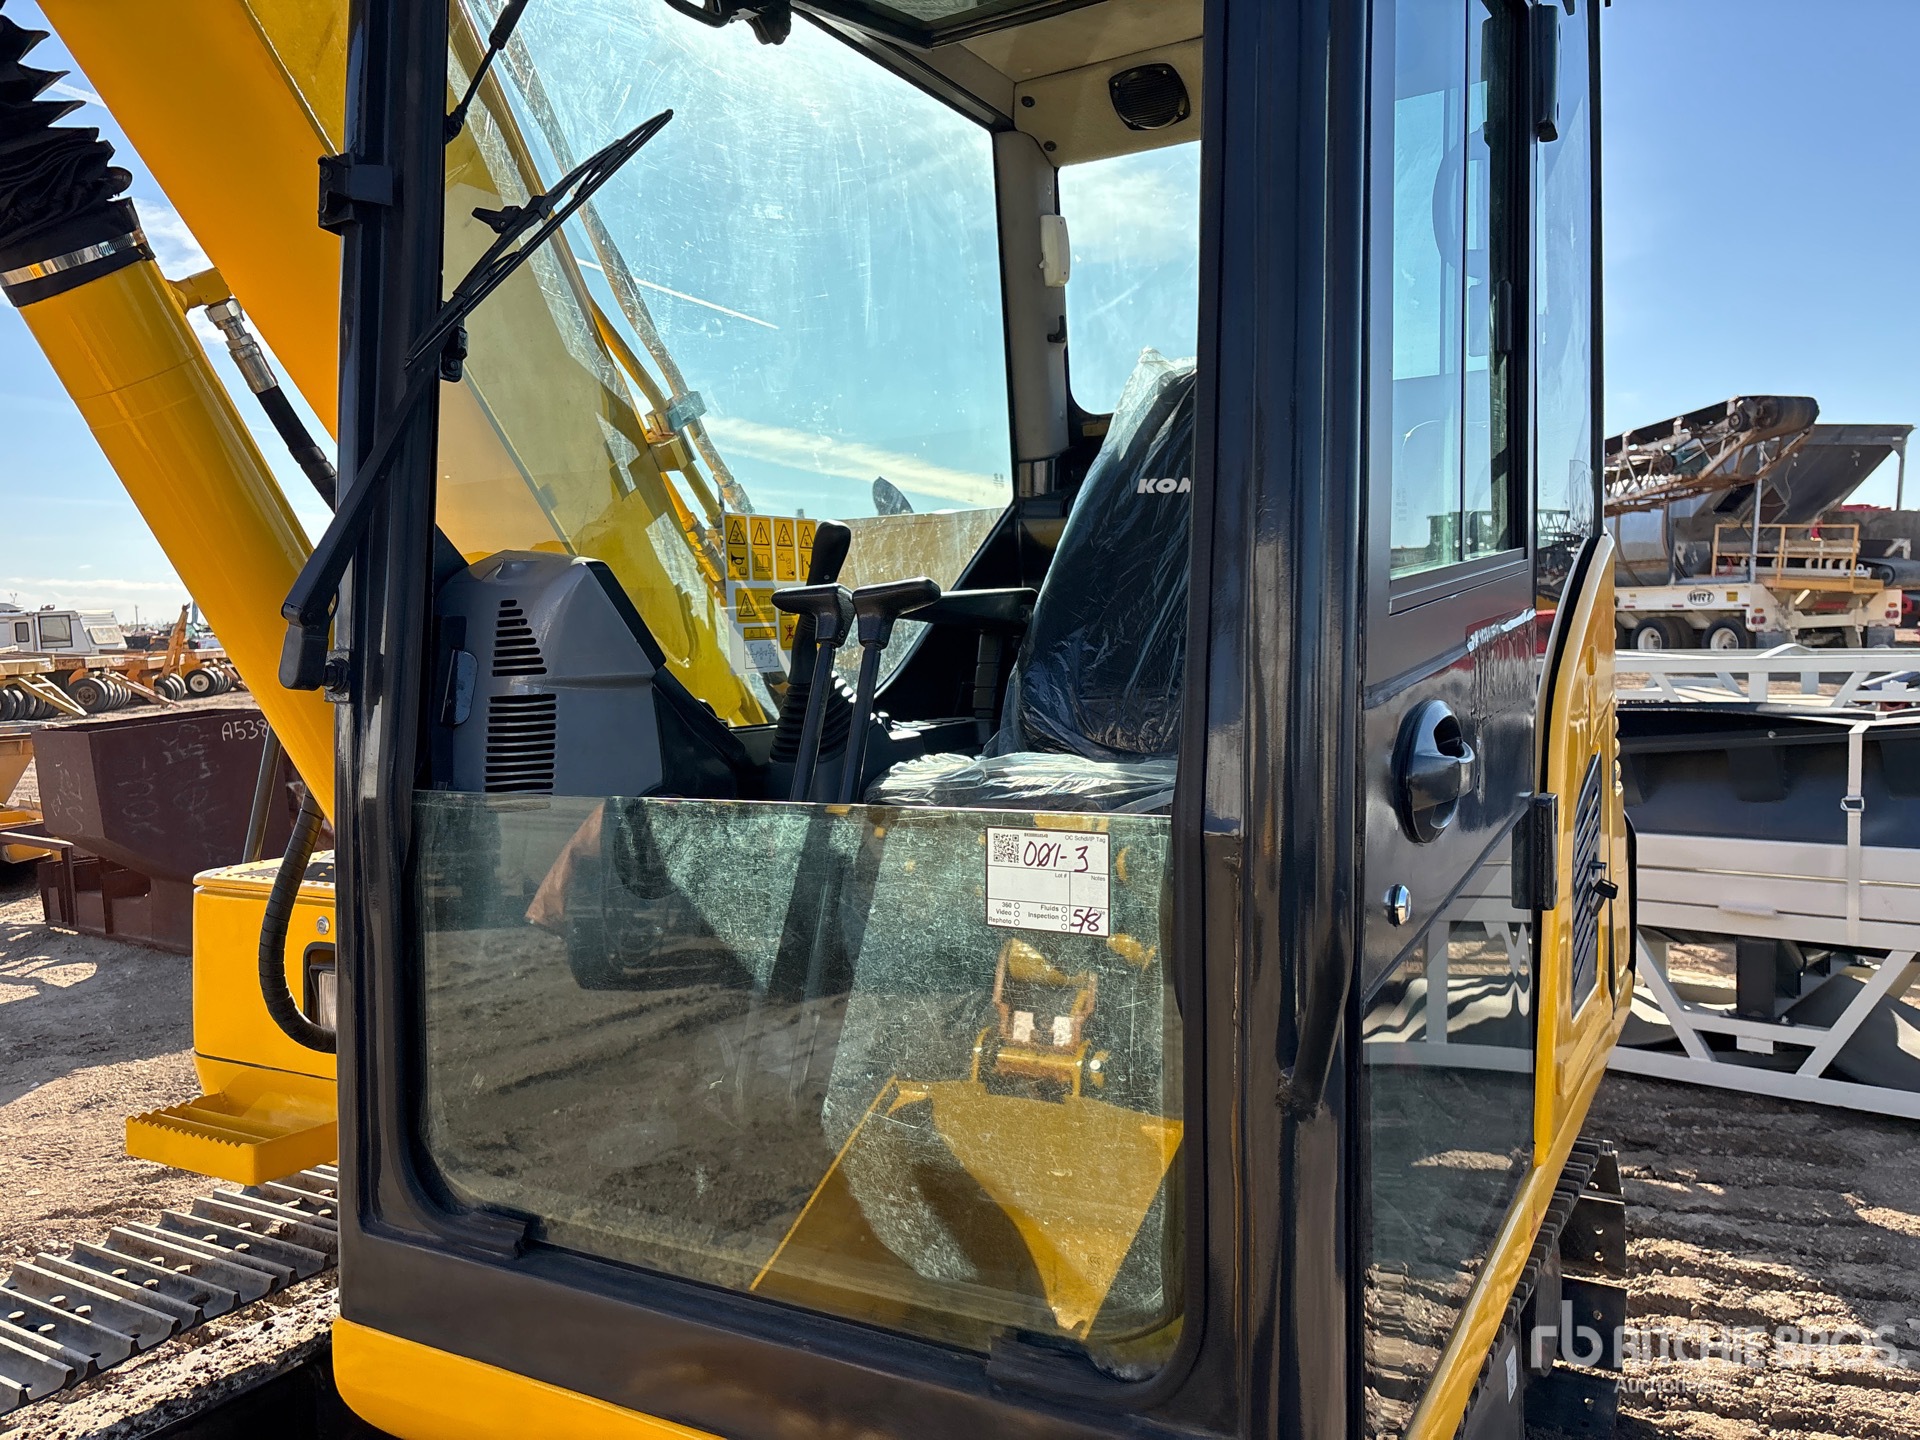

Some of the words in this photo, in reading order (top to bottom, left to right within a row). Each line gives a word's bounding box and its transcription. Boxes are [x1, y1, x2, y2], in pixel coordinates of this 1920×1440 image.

[1096, 836, 1106, 844] Tag
[996, 908, 1012, 916] Video
[1040, 904, 1059, 912] Fluids
[1028, 911, 1059, 921] Inspection
[988, 916, 1012, 925] Rephoto
